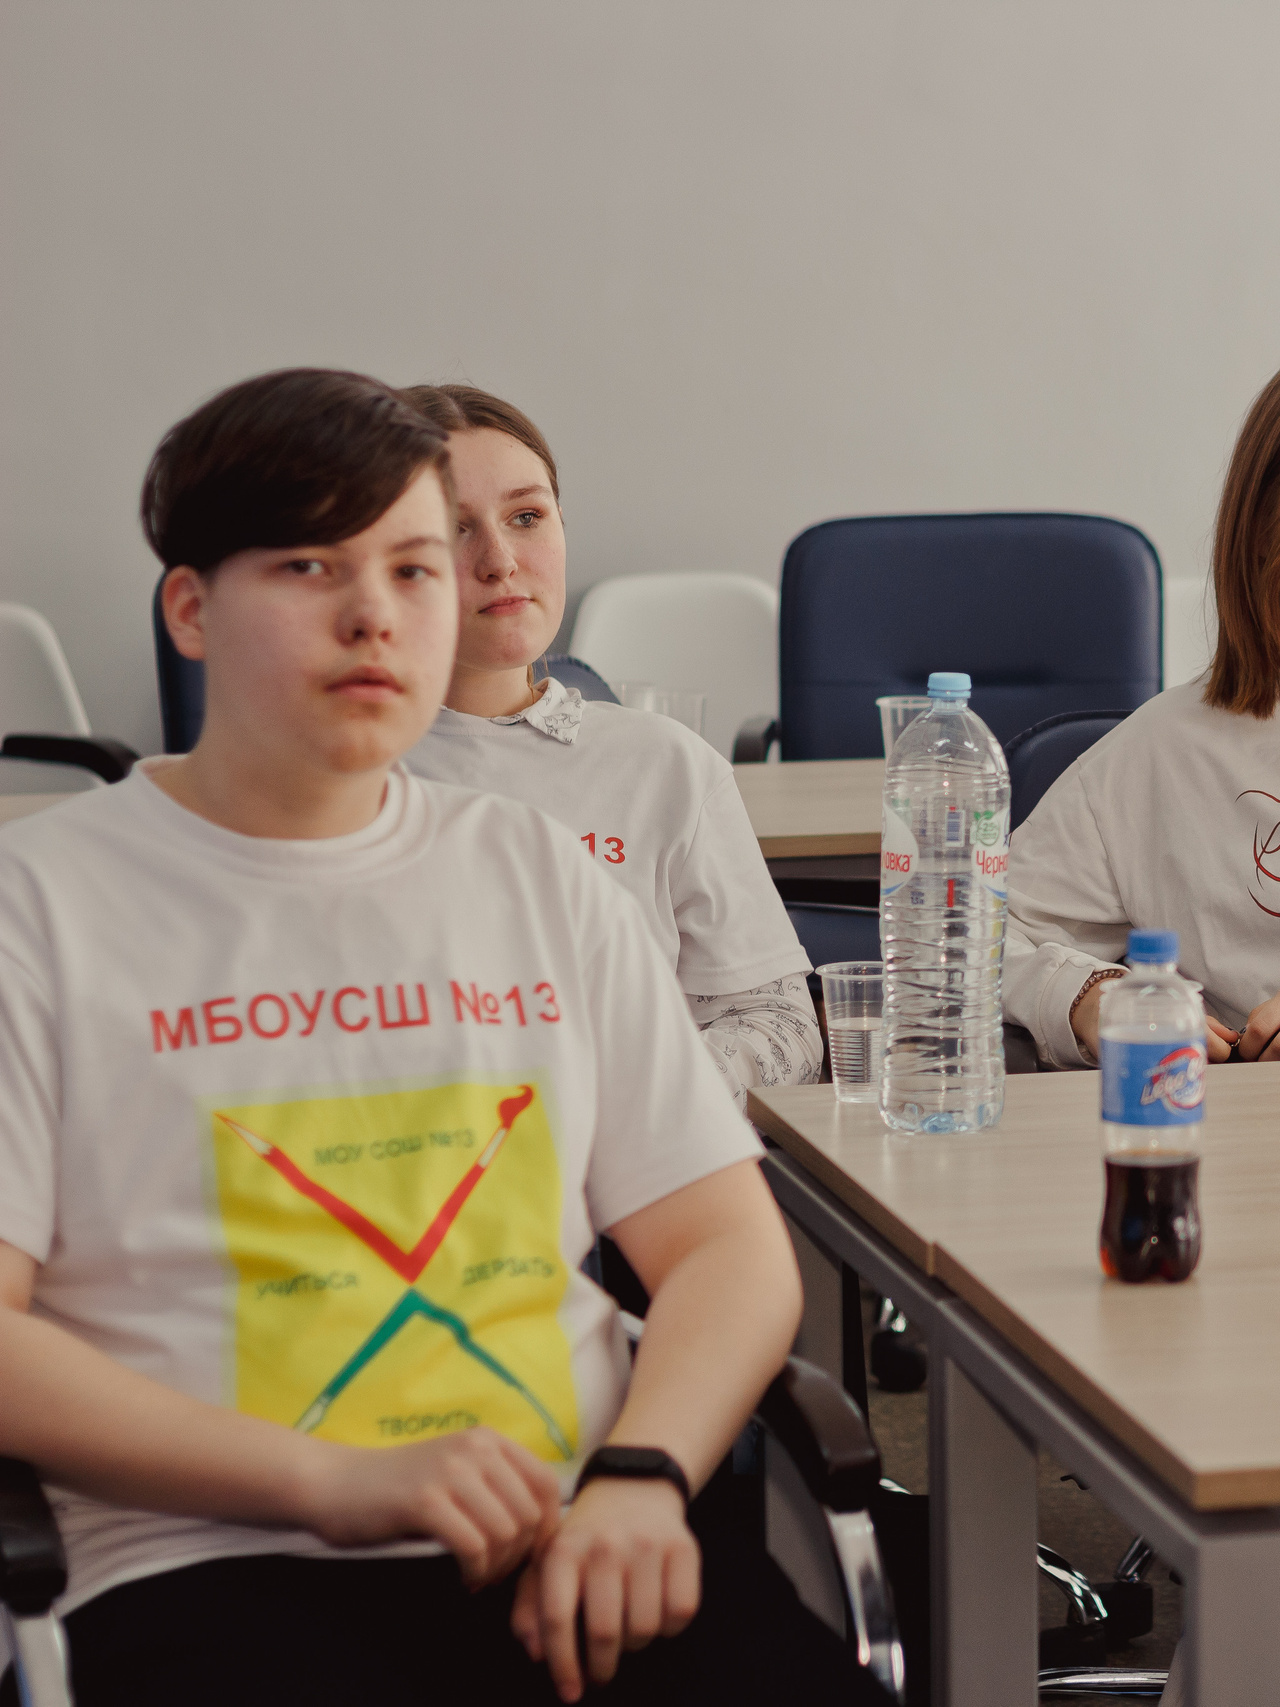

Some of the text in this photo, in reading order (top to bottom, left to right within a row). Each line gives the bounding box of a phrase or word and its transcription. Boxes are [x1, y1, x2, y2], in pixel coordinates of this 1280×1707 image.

[883, 851, 913, 873] овка
[150, 981, 562, 1053] МБОУСШ №13
